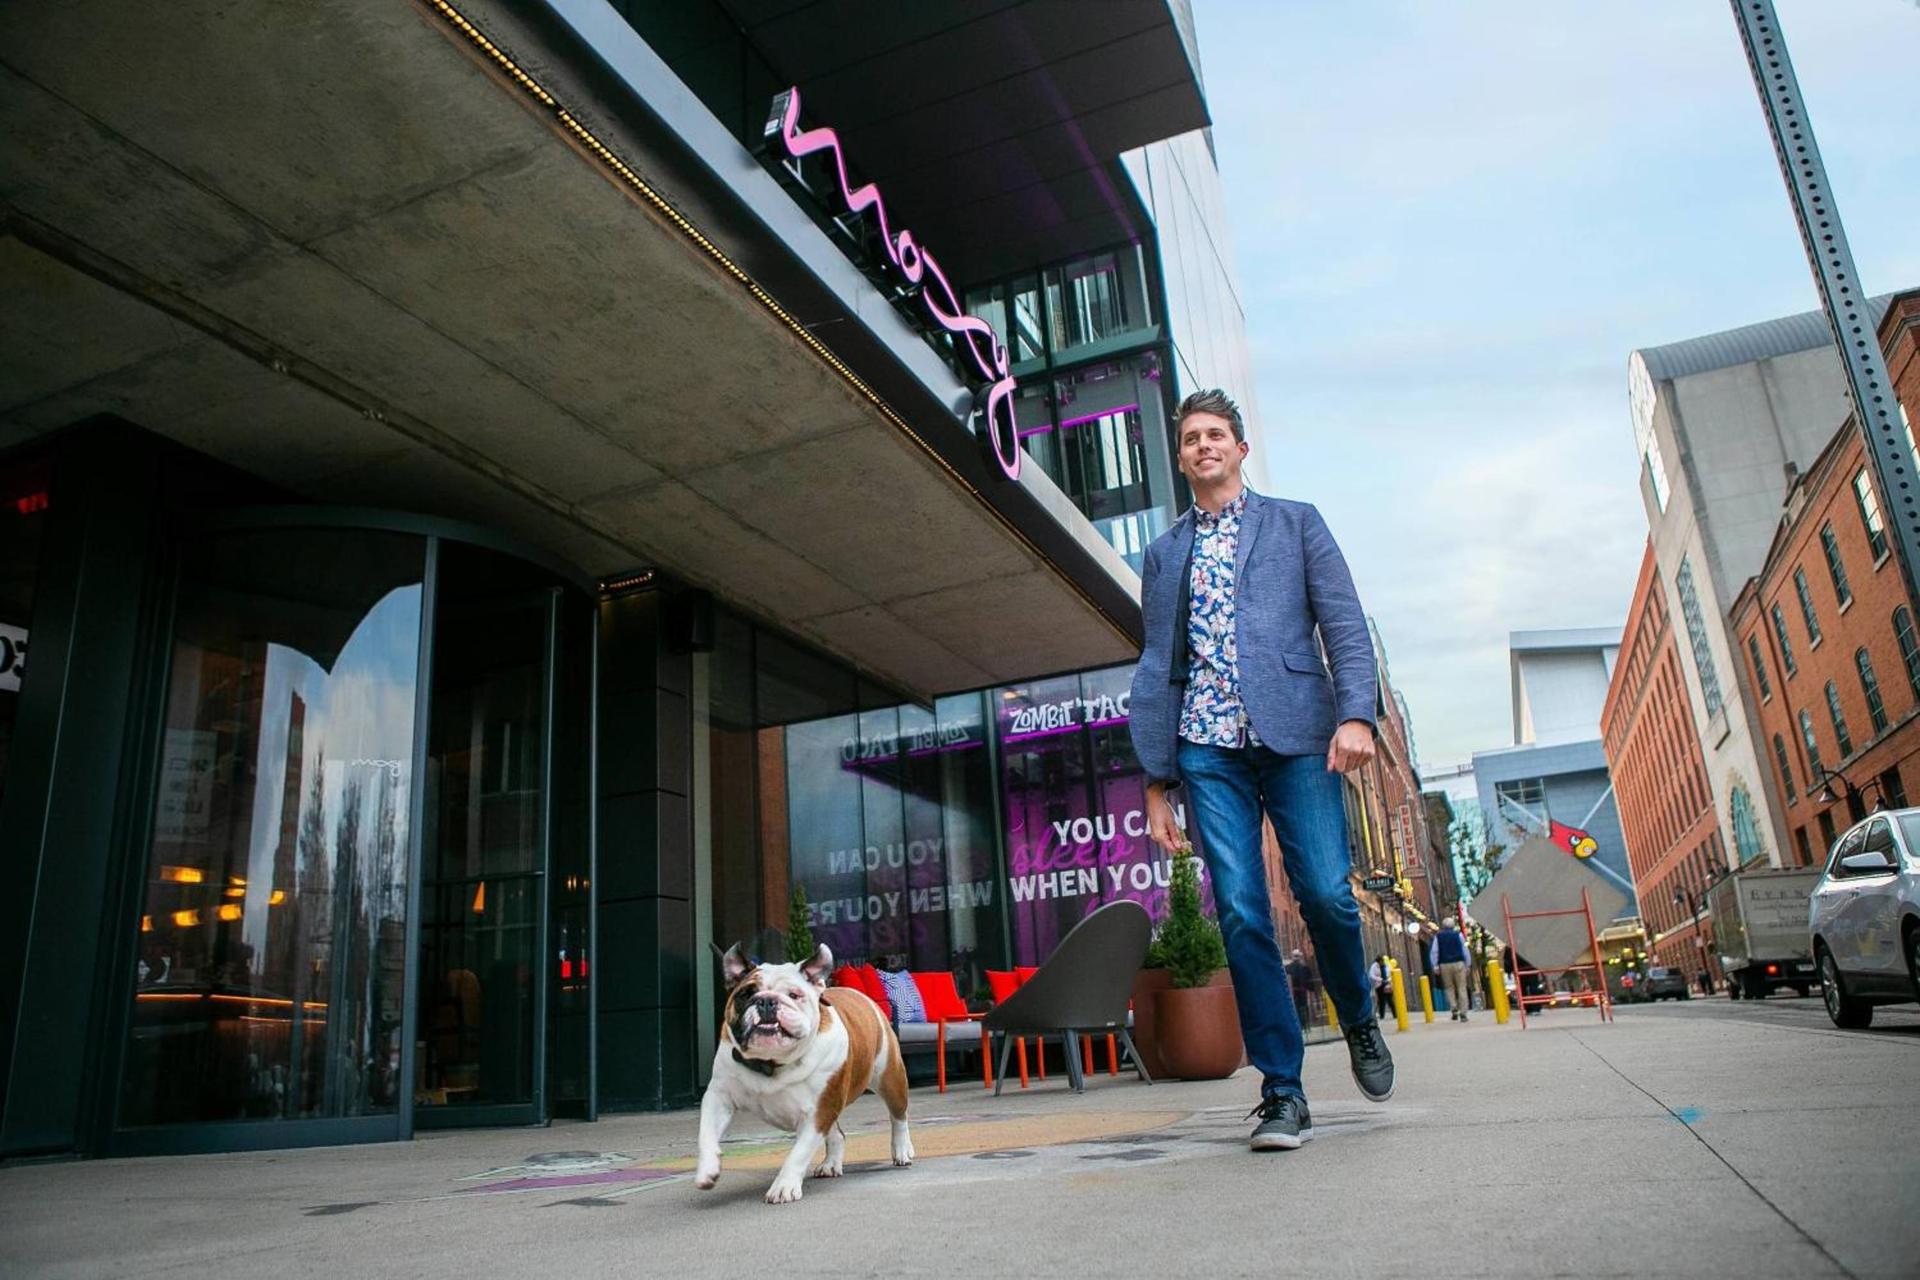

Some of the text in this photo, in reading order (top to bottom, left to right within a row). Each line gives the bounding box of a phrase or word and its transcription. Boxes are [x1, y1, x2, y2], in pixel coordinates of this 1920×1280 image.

[1076, 690, 1131, 723] TAC
[1053, 803, 1187, 847] YOU CN
[1009, 866, 1099, 902] WHEN
